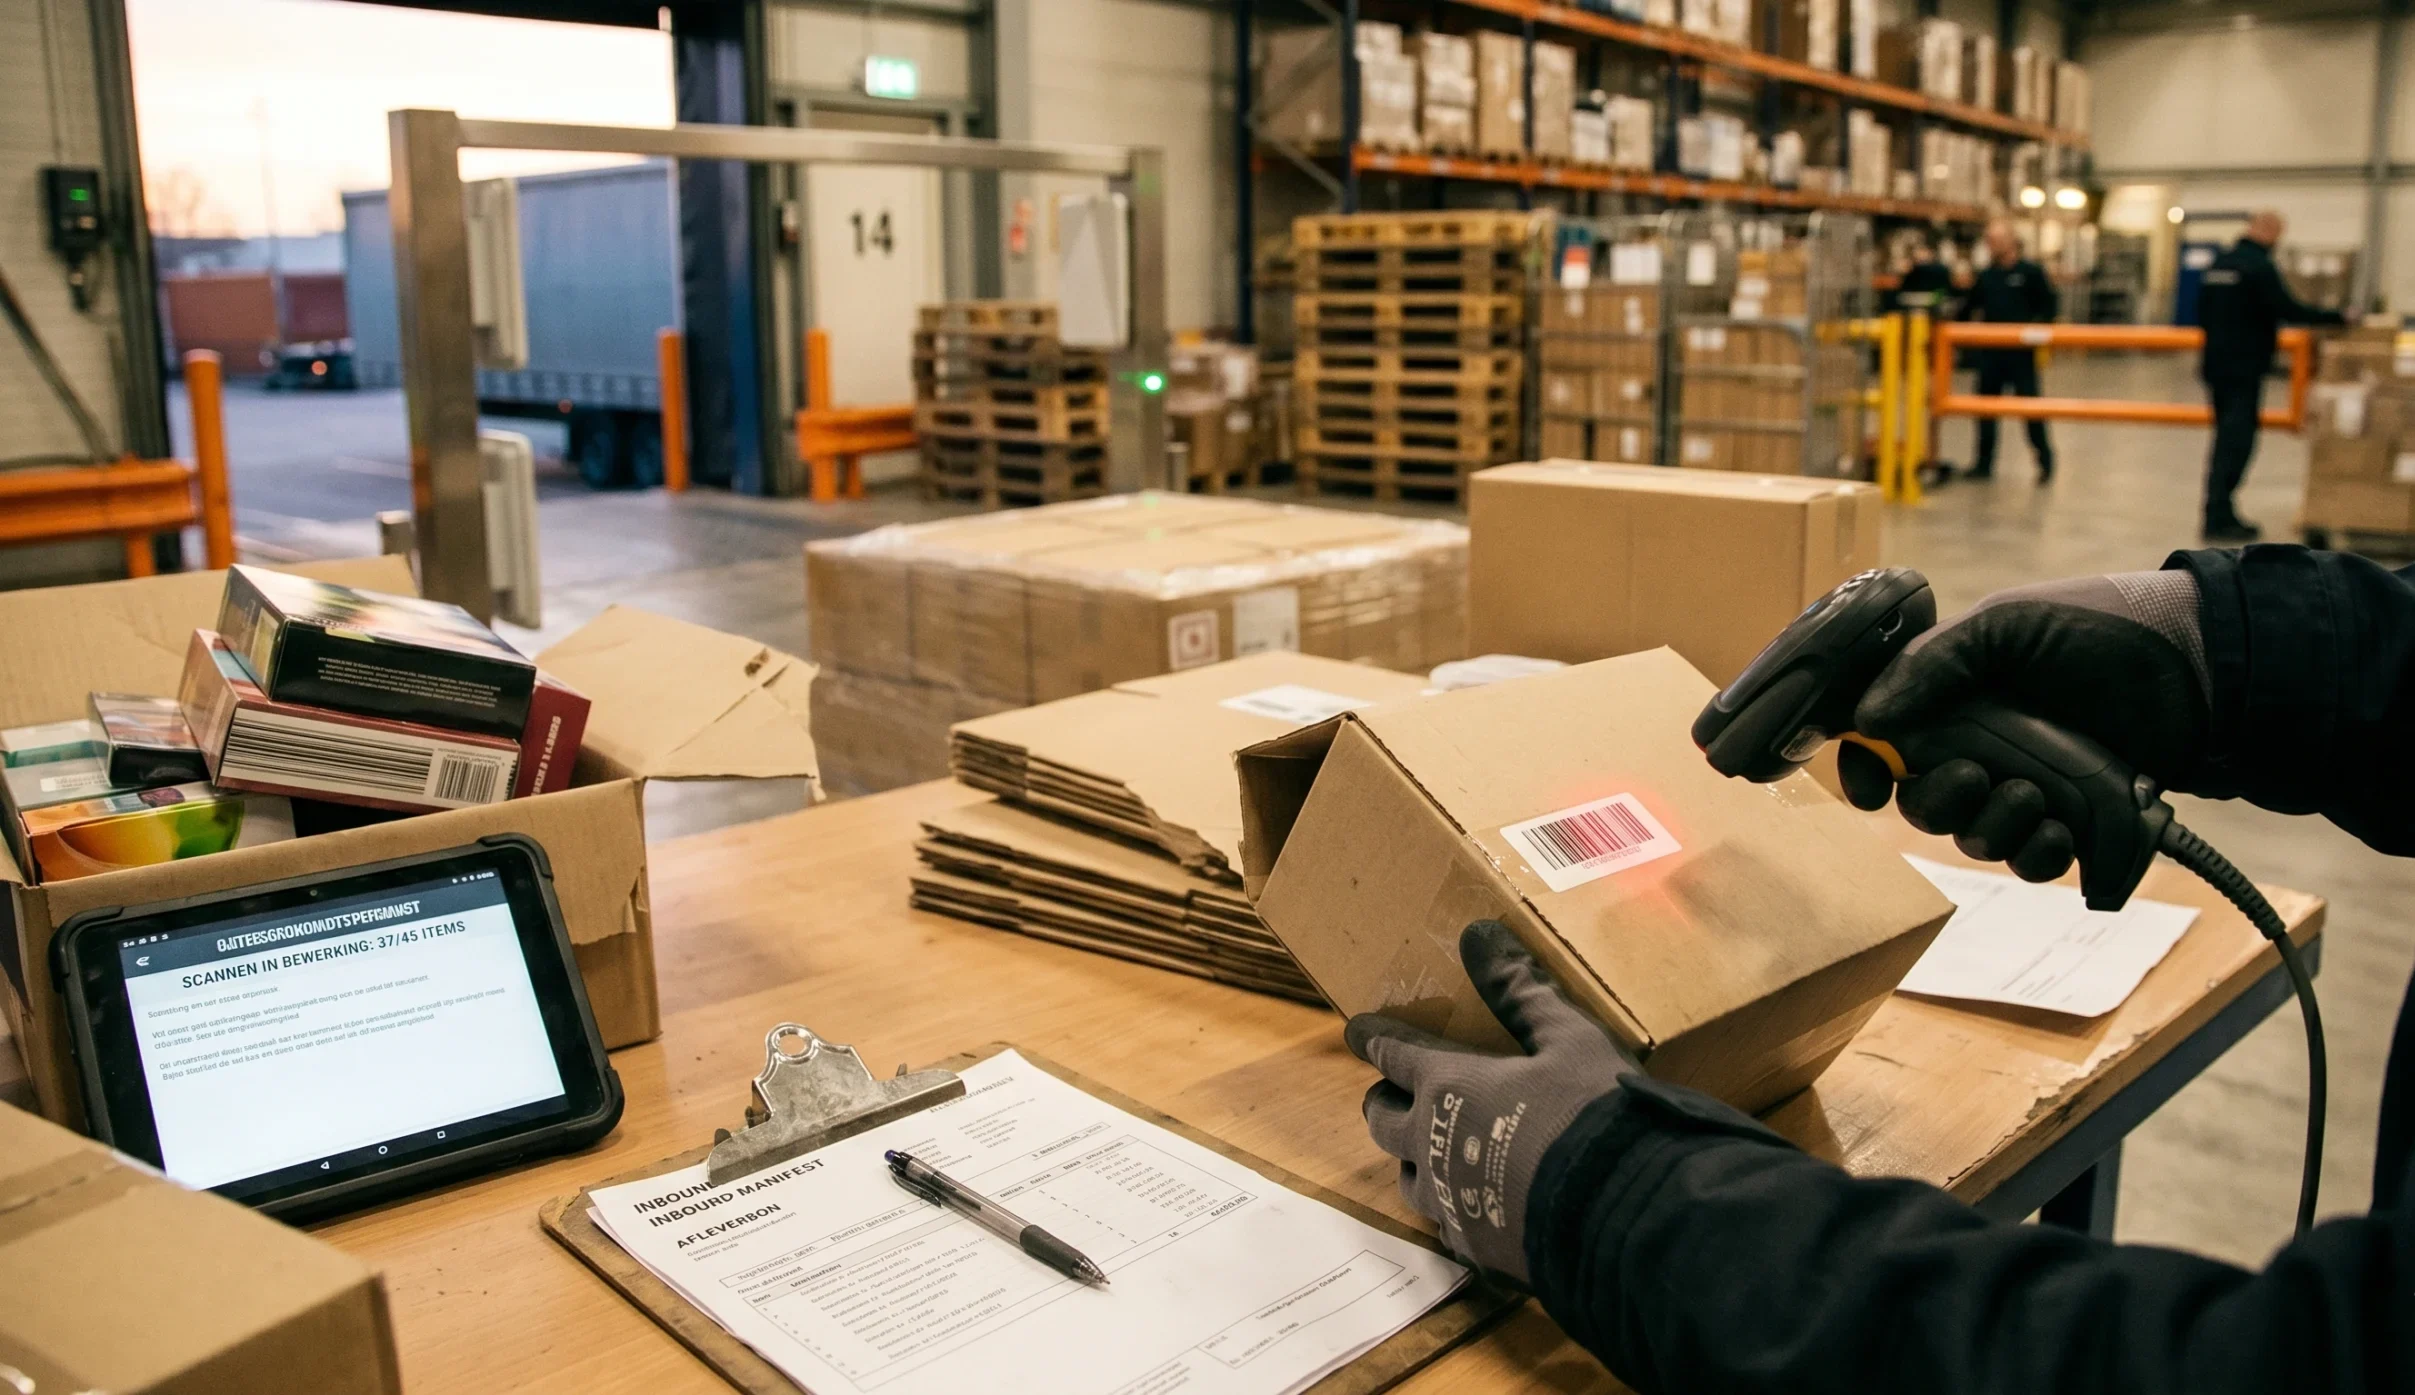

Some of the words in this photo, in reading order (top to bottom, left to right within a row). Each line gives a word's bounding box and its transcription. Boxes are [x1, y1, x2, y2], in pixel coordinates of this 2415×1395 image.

[850, 209, 895, 257] 14
[182, 962, 258, 989] SCANNEN
[262, 958, 279, 972] IN
[282, 940, 374, 968] BEWERKING:
[376, 929, 418, 949] 37/45
[421, 920, 466, 939] ITEMS
[736, 1158, 825, 1197] MANIFEST
[676, 1203, 782, 1249] AFLEVERBON
